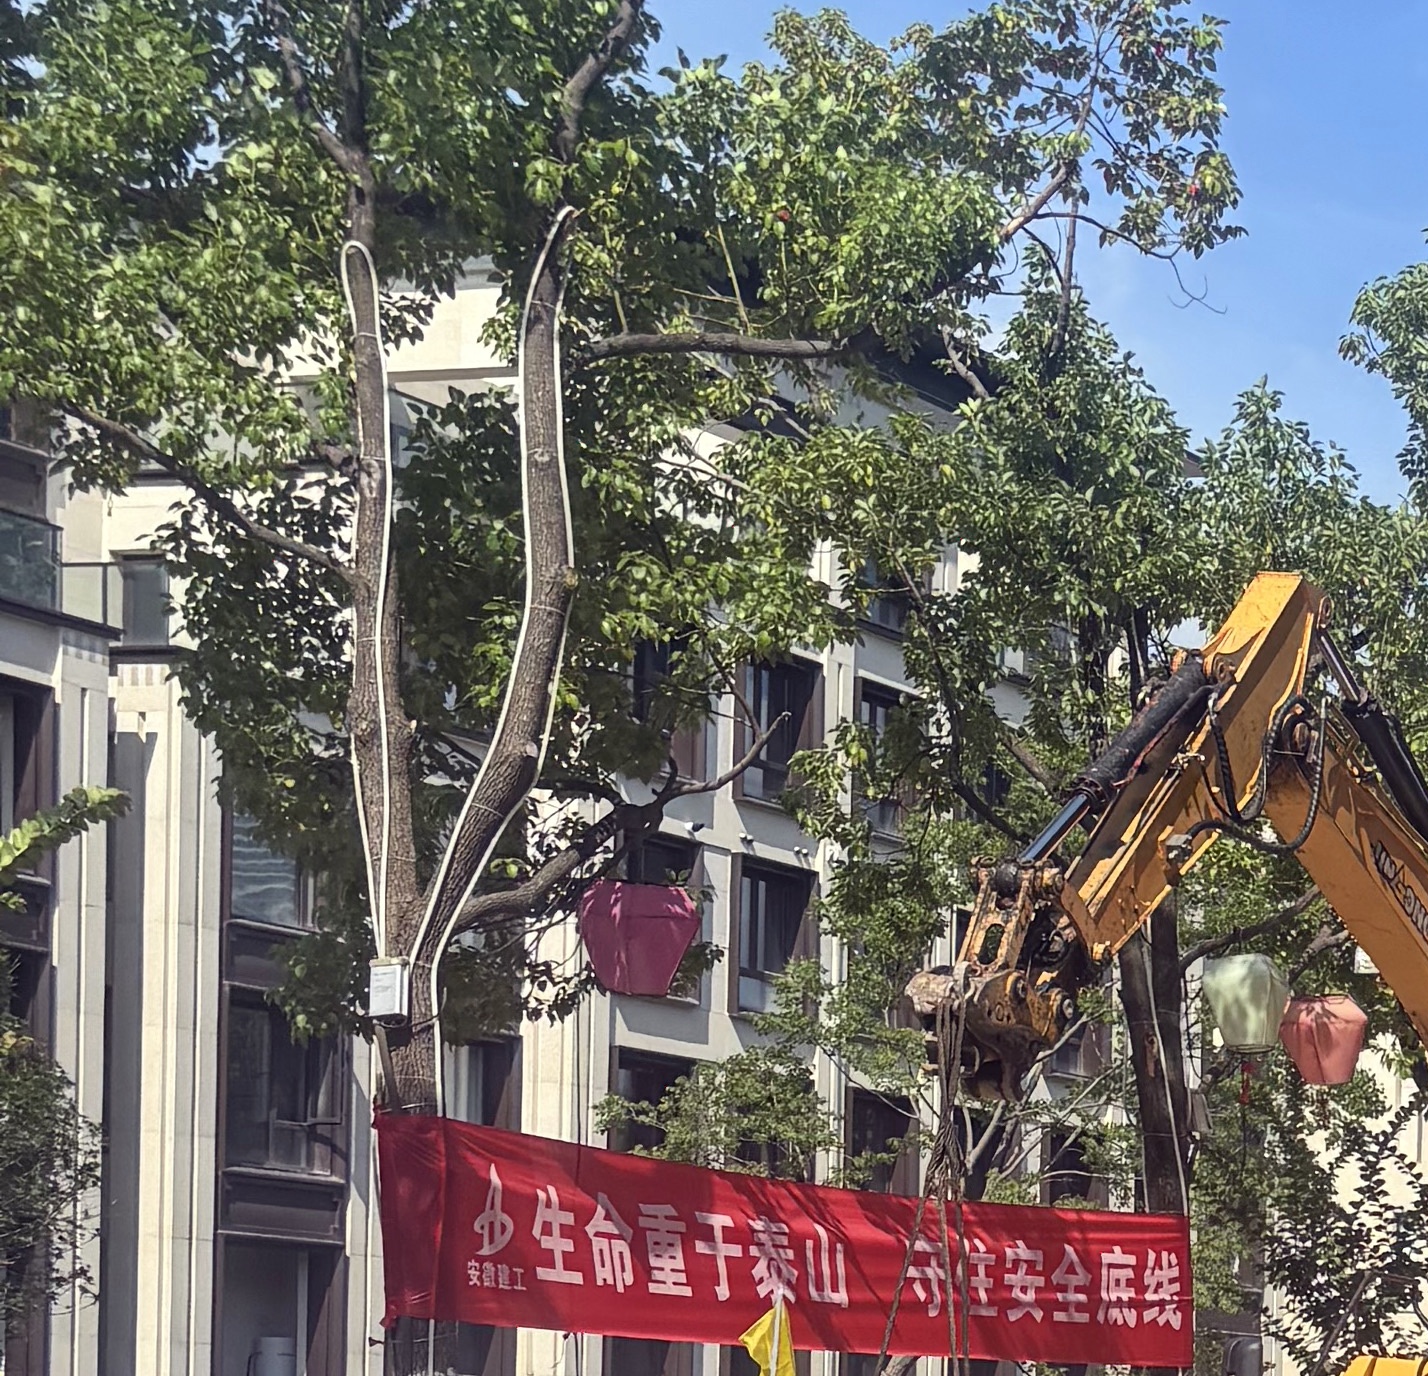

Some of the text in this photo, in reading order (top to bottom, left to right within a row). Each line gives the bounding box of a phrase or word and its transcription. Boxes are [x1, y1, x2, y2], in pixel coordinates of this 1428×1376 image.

[467, 1259, 527, 1291] 安徽建工
[532, 1185, 849, 1308] 生命重于泰山
